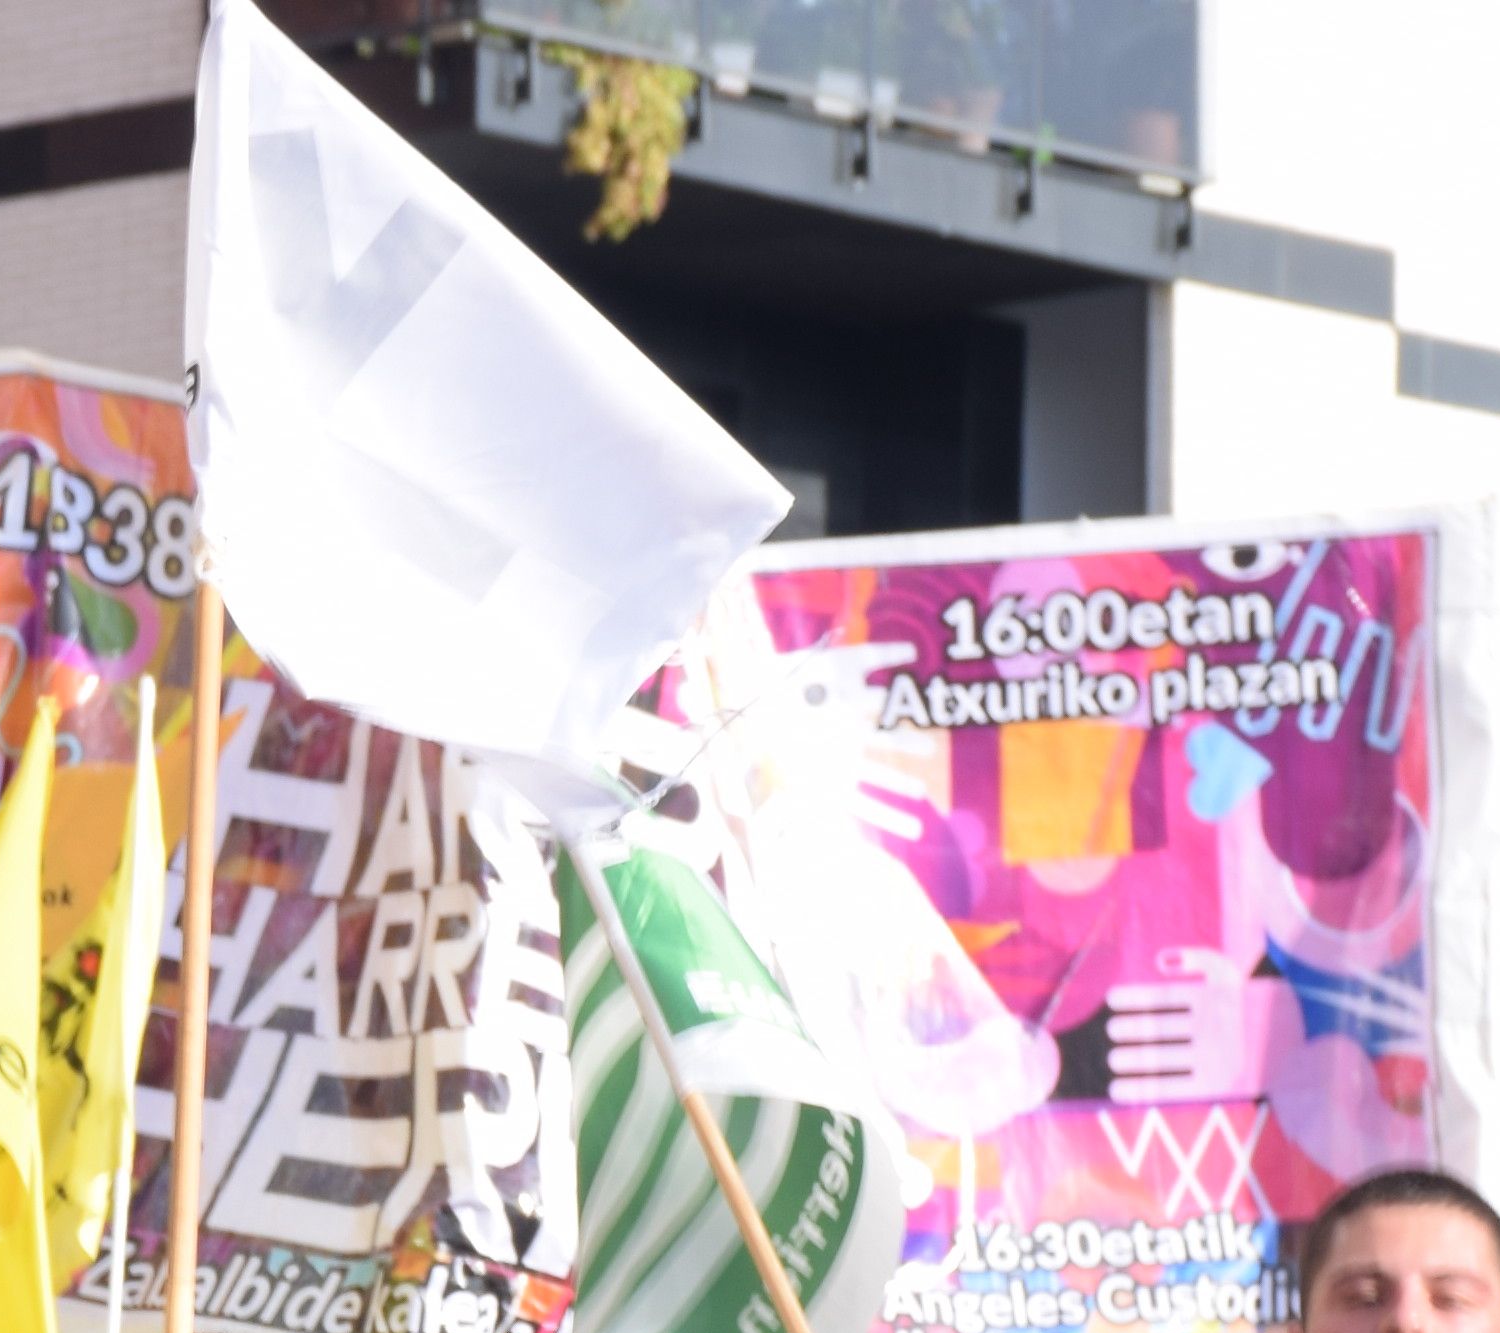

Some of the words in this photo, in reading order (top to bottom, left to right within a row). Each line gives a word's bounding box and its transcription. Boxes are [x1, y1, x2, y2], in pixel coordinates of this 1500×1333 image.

[942, 588, 1276, 660] 16:00etan
[880, 660, 1139, 730] Atxuriko
[1150, 652, 1340, 725] plazan
[957, 1212, 1259, 1272] 16:30etatik
[1096, 1266, 1302, 1325] Custodi
